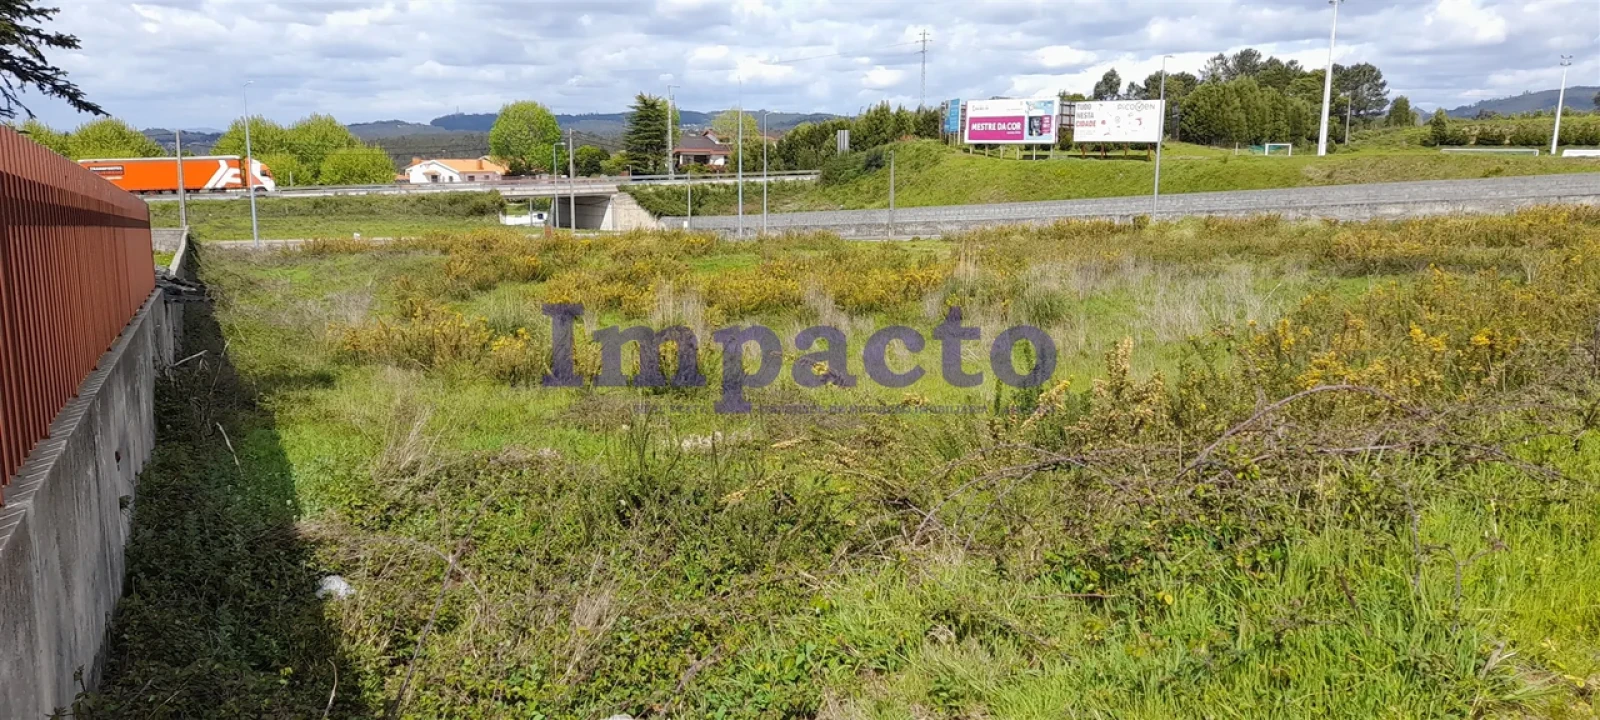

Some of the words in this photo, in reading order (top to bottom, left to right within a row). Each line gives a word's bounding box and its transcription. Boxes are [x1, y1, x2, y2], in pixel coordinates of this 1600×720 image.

[971, 122, 996, 131] MESTRE
[997, 122, 1007, 131] DA
[1007, 121, 1022, 131] COR
